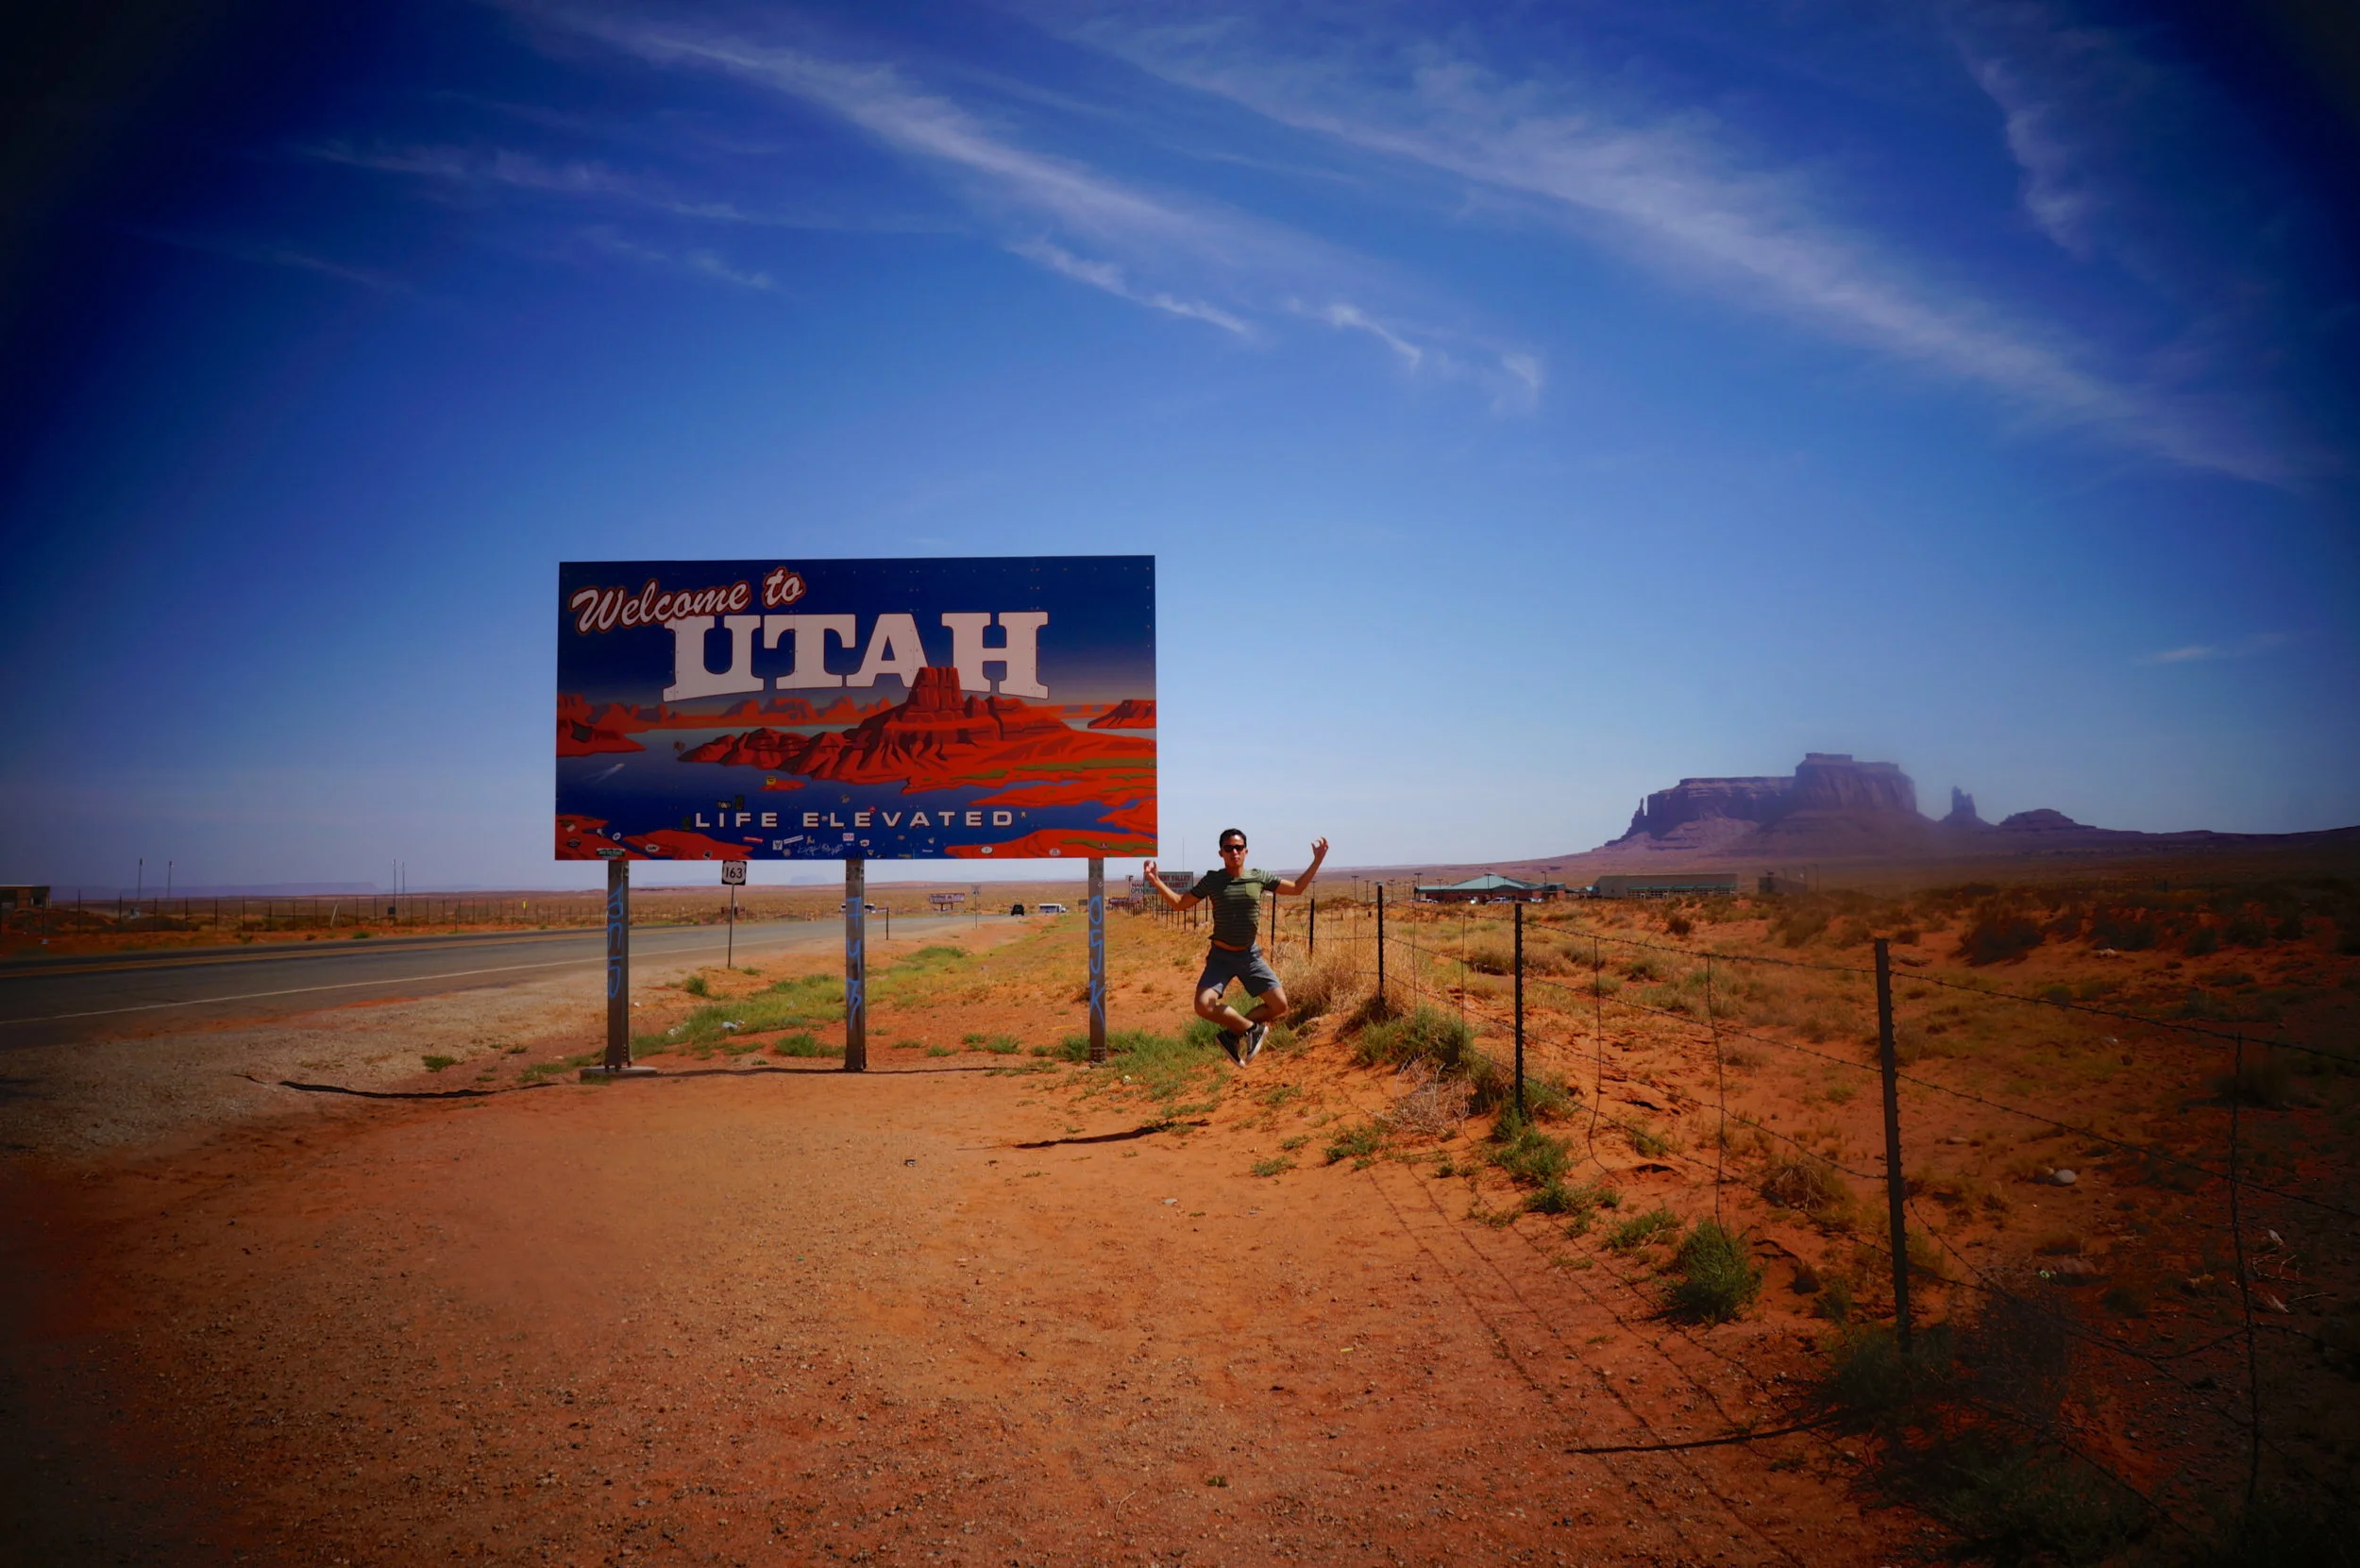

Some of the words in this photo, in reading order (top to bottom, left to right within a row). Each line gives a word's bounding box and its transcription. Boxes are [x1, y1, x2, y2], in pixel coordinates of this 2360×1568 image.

[571, 580, 750, 633] Welcome
[765, 567, 804, 608] to
[663, 612, 1049, 701] UTAH
[696, 812, 778, 828] LIFE
[802, 811, 1012, 828] ELEVATED
[725, 867, 743, 879] 163
